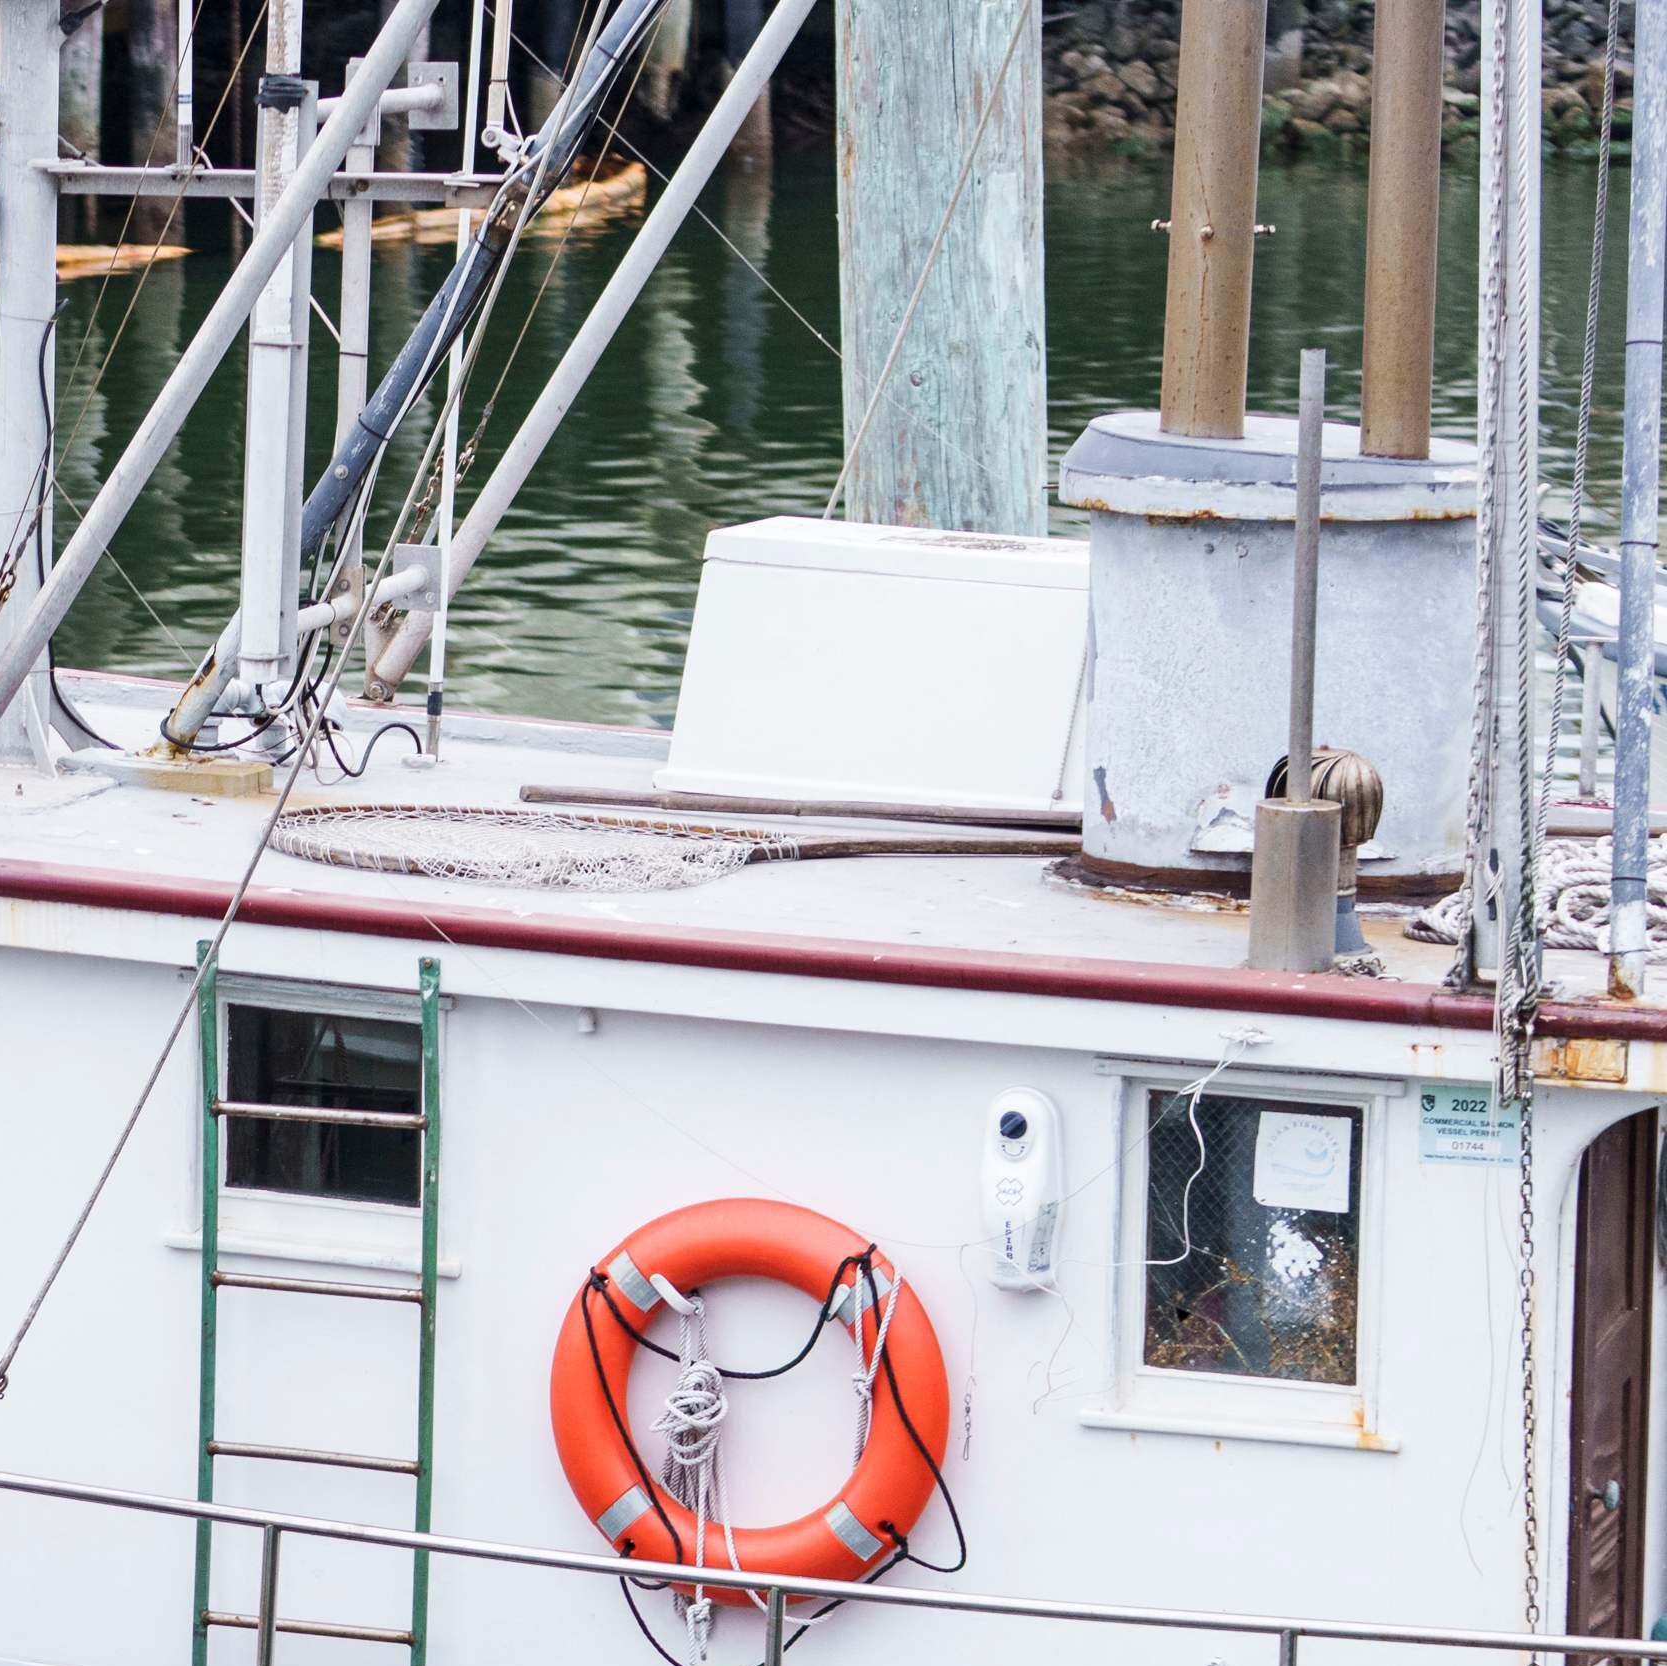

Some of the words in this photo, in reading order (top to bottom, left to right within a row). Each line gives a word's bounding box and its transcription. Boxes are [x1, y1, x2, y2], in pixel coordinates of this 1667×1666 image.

[1451, 1099, 1487, 1113] 2022
[1422, 1117, 1477, 1127] COMMERCIAL
[1436, 1127, 1468, 1136] VESSEL
[1451, 1141, 1484, 1151] 01744
